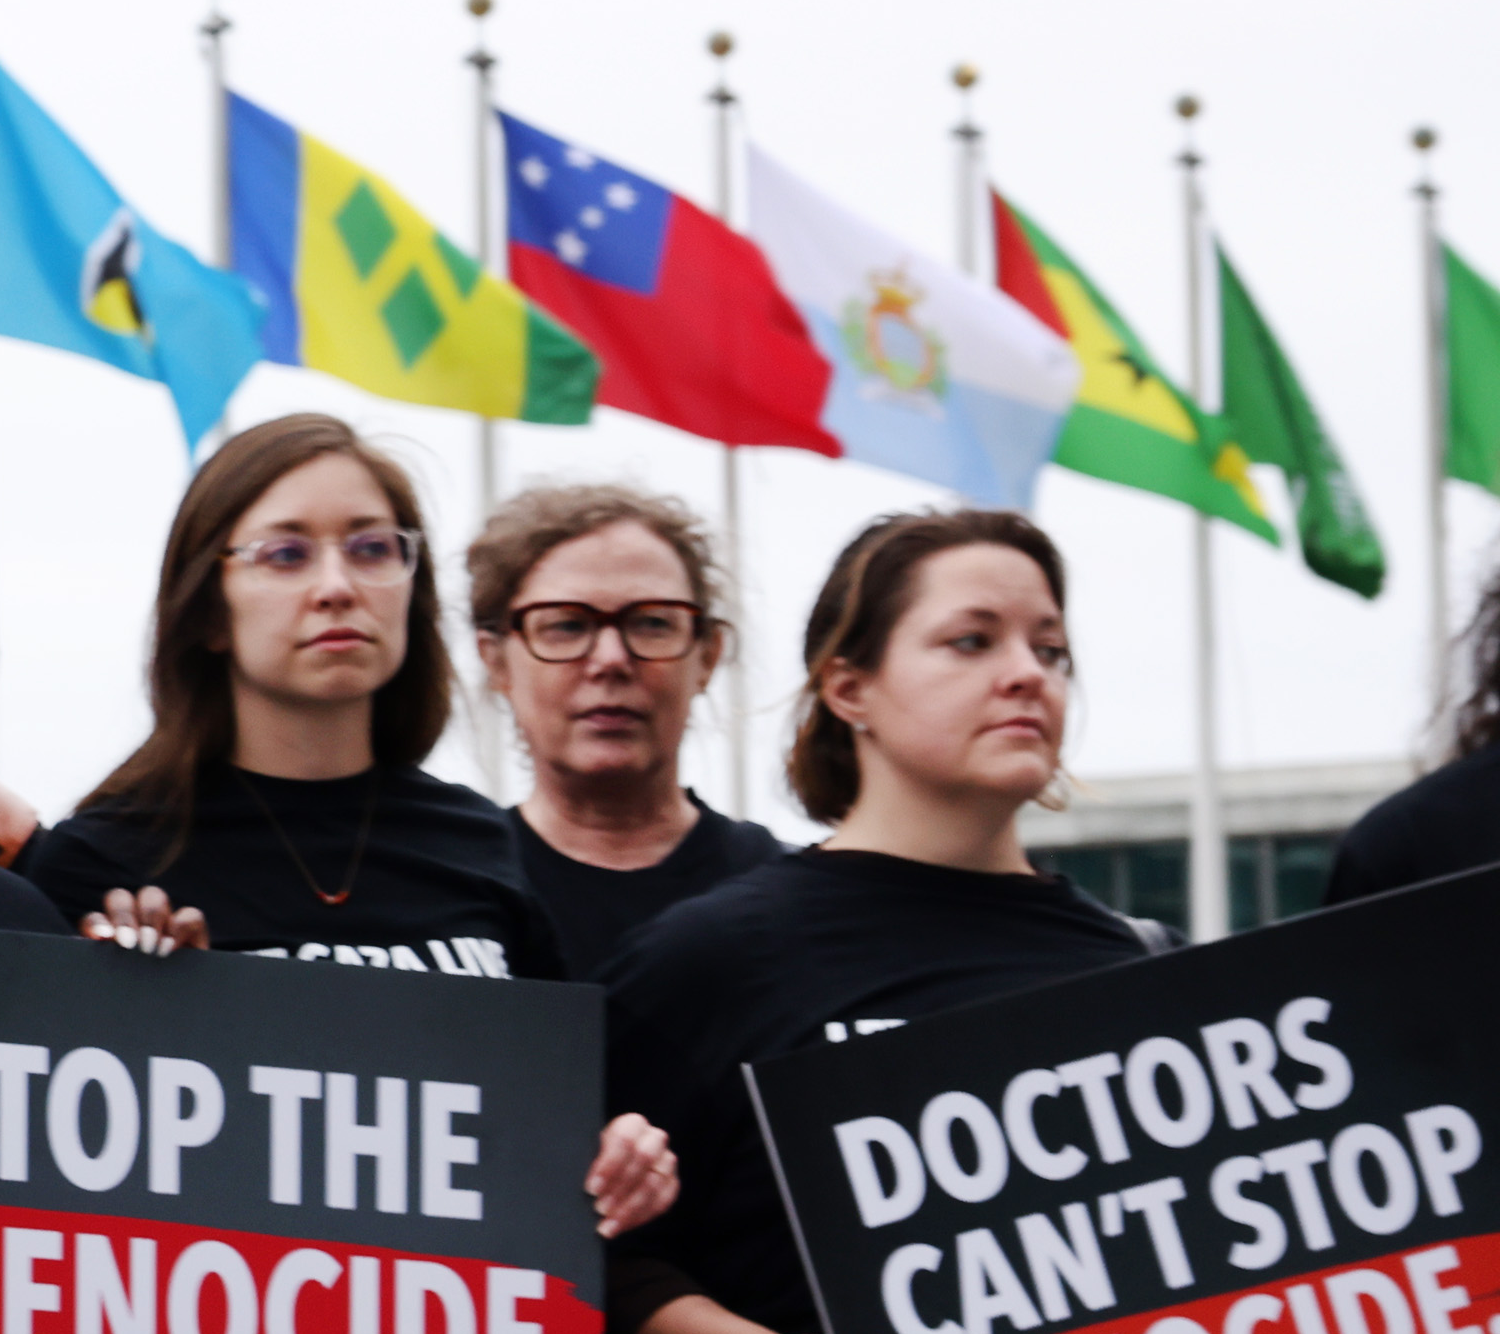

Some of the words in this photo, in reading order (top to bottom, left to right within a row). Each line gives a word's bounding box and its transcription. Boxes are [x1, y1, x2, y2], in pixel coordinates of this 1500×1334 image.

[251, 1066, 481, 1219] THE
[834, 998, 1351, 1227] DOCTORS
[1212, 1106, 1479, 1269] STOP
